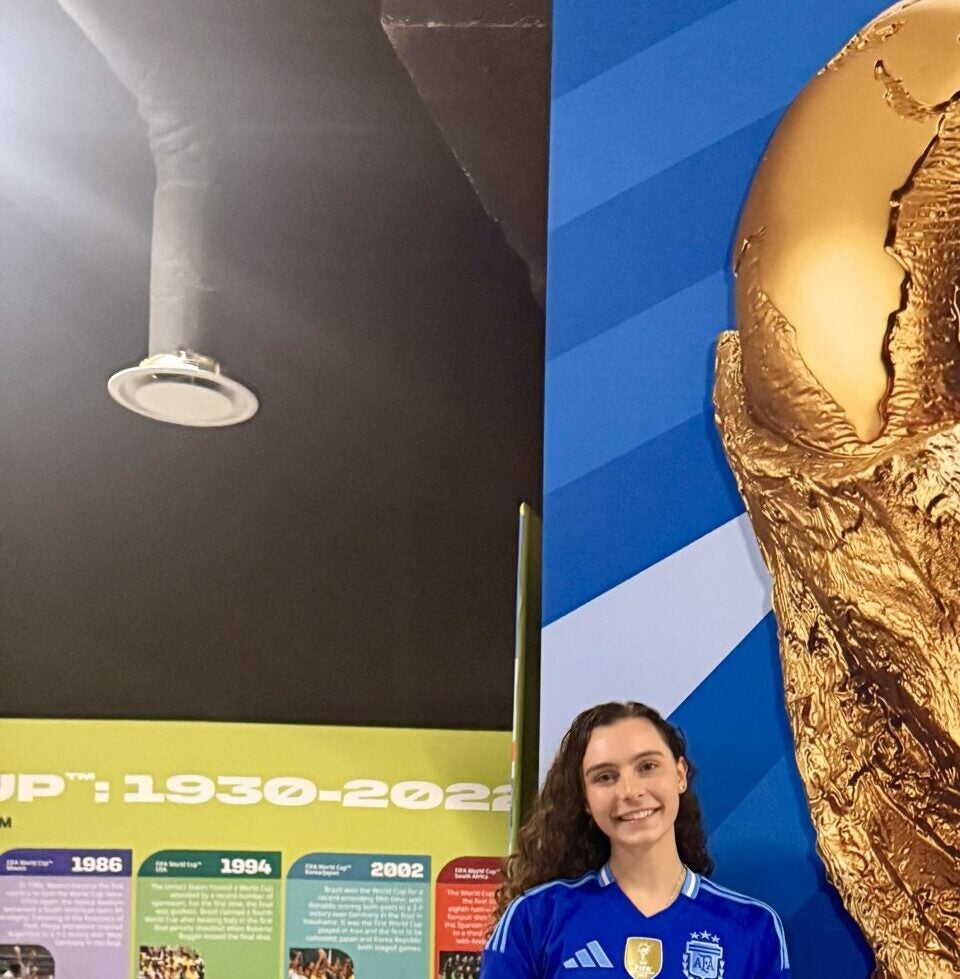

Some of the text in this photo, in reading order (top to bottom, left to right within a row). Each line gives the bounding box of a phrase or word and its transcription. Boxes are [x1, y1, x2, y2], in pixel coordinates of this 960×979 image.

[71, 857, 123, 872] 1986
[221, 858, 272, 875] 1994
[370, 862, 424, 878] 2002
